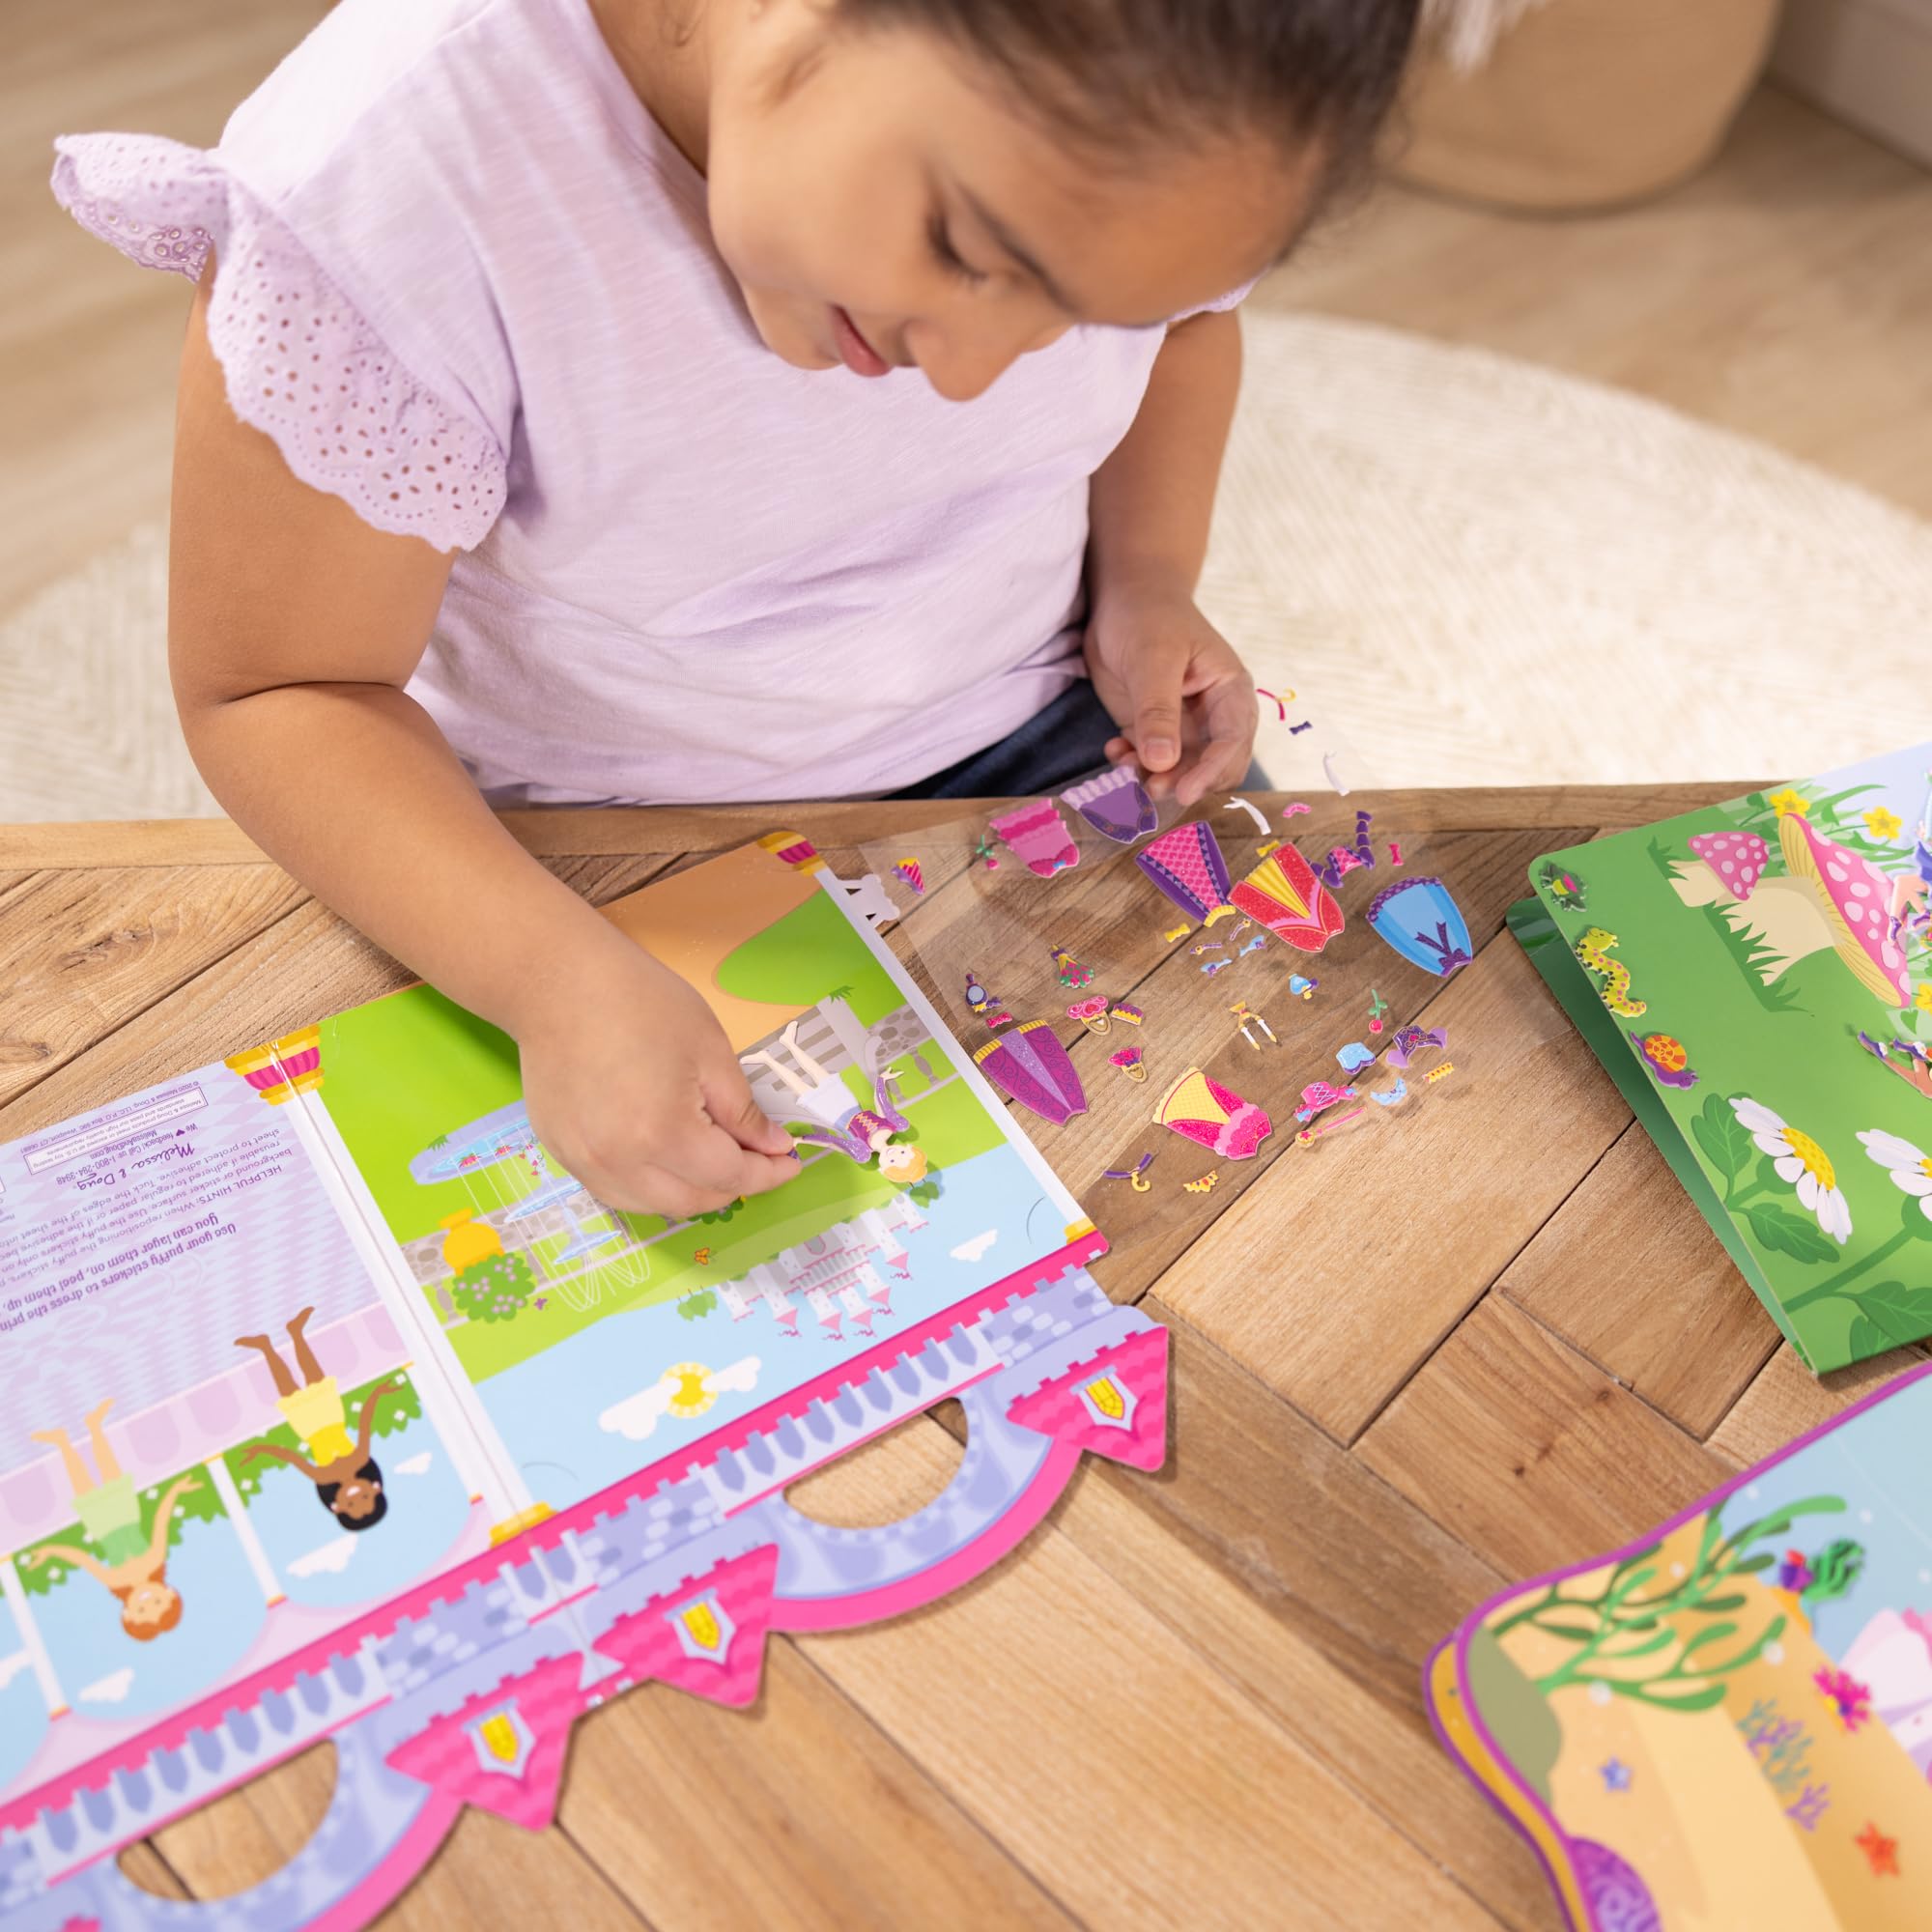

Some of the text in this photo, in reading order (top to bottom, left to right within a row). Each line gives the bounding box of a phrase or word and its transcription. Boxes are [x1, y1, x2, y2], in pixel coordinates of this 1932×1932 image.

[179, 1098, 201, 1110] Melissa
[130, 1115, 156, 1128] products
[144, 1109, 156, 1118] and
[156, 1109, 173, 1119] Doug
[185, 1122, 197, 1131] We
[89, 1128, 156, 1159] MelissaAndDoug.com
[141, 1132, 173, 1150] feedback!
[253, 1128, 279, 1144] sheet
[128, 1145, 141, 1155] Call
[130, 1143, 194, 1168] Melissa
[203, 1143, 239, 1163] protect
[239, 1140, 280, 1160] reusable
[156, 1159, 201, 1180] adhesive.
[230, 1157, 238, 1166] if
[235, 1148, 292, 1176] background
[187, 1160, 228, 1182] adhered
[222, 1171, 234, 1179] or
[233, 1164, 281, 1188] HELPFUL
[76, 1172, 115, 1190] Doug
[132, 1179, 155, 1193] Tuck
[175, 1178, 186, 1186] to
[189, 1177, 221, 1193] sticker
[113, 1189, 131, 1200] the
[140, 1183, 174, 1201] regular
[150, 1190, 186, 1209] surface.
[198, 1184, 232, 1204] HINTS:
[81, 1197, 111, 1212] edges
[109, 1197, 137, 1214] paper
[163, 1201, 194, 1216] When
[51, 1215, 69, 1226] the
[70, 1209, 80, 1221] of
[86, 1217, 94, 1226] if
[96, 1211, 106, 1220] or
[108, 1216, 127, 1227] the
[128, 1208, 147, 1219] Use
[20, 1223, 48, 1239] sheet
[67, 1221, 84, 1232] the
[81, 1224, 106, 1239] puffy
[97, 1213, 162, 1244] repositioning
[172, 1225, 193, 1238] can
[213, 1222, 236, 1236] Use
[19, 1229, 65, 1251] adhesive
[40, 1236, 79, 1257] stickers
[79, 1241, 97, 1253] the
[141, 1234, 172, 1253] layer
[185, 1230, 213, 1250] your
[16, 1253, 39, 1266] only
[51, 1248, 77, 1265] puffy
[106, 1248, 139, 1267] them
[149, 1242, 184, 1264] puffy
[85, 1263, 105, 1275] on,
[100, 1260, 148, 1287] stickers
[58, 1269, 84, 1291] peel
[84, 1282, 99, 1293] to
[23, 1284, 57, 1303] them
[49, 1289, 83, 1309] dress
[26, 1304, 48, 1320] the
